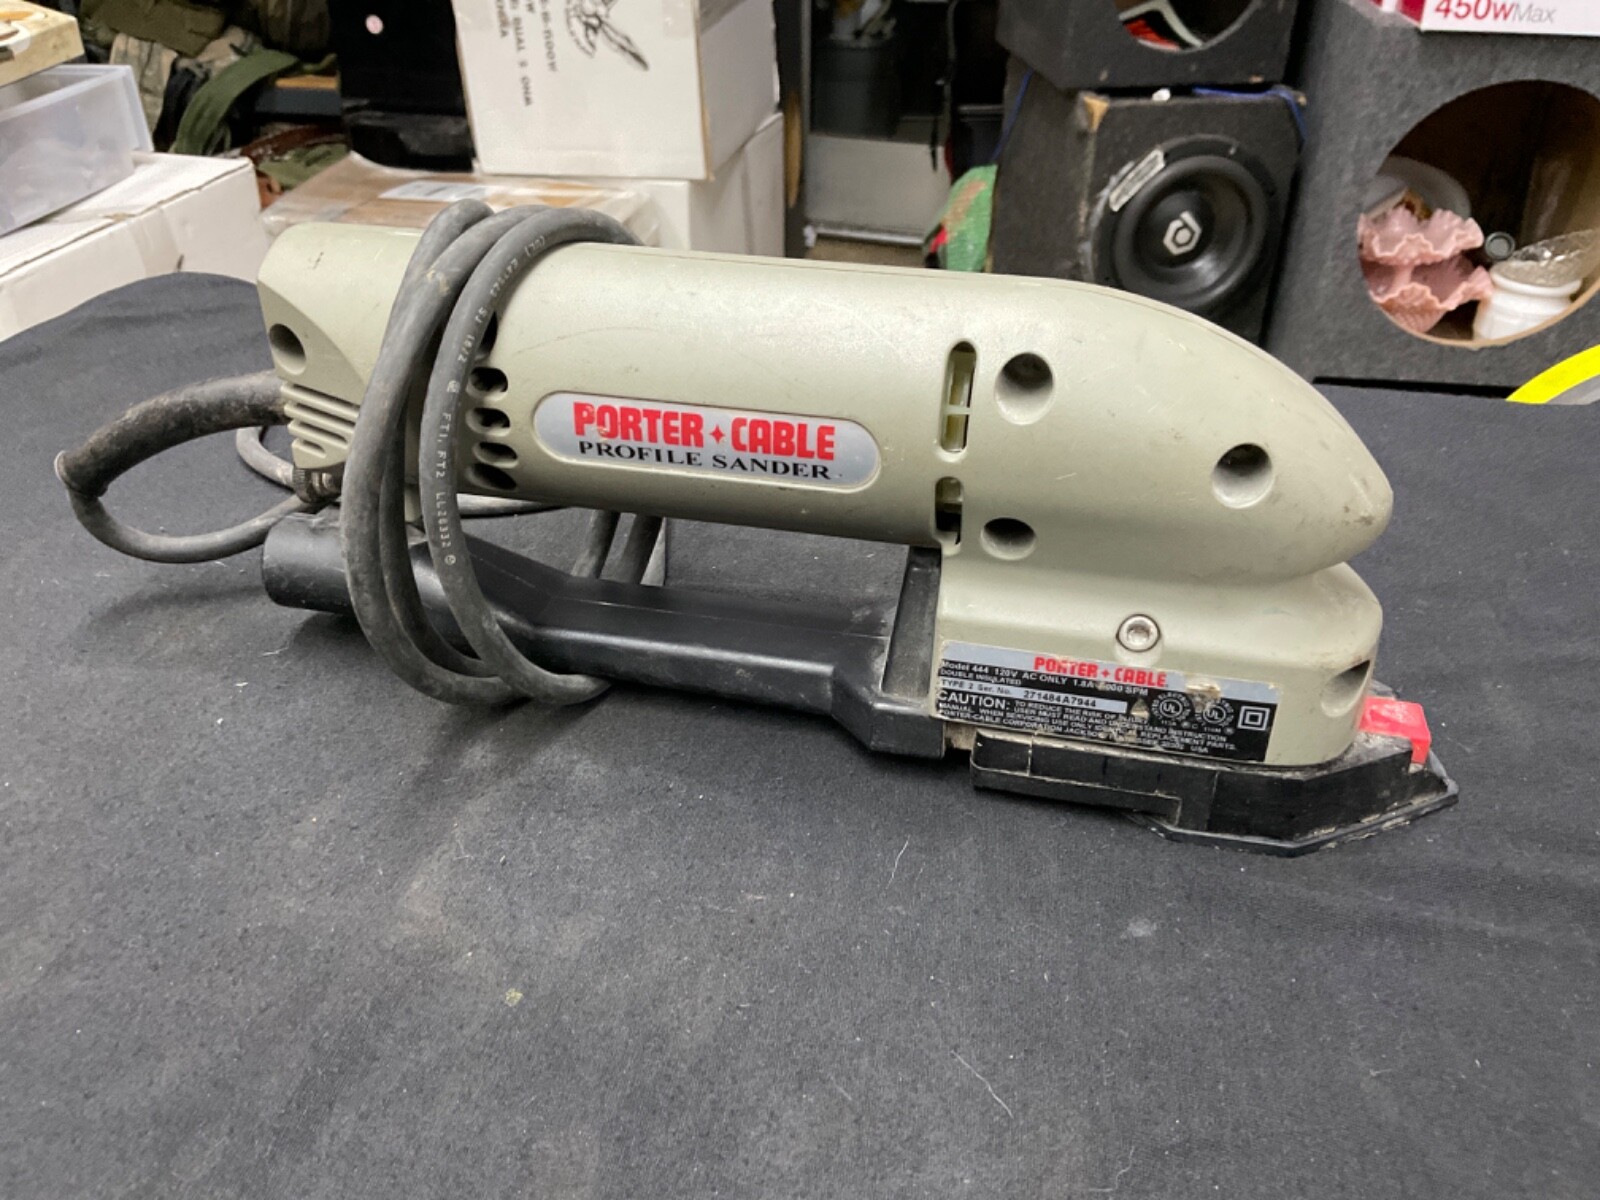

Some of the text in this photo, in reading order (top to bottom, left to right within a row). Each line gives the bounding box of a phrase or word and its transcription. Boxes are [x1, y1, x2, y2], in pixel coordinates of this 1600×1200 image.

[573, 402, 836, 461] PORTER CABLE
[435, 450, 448, 478] FT2
[578, 440, 831, 481] PROFILE SANDER
[940, 669, 1022, 685] DOUBLE INSULATED
[941, 661, 970, 671] Model
[971, 665, 989, 673] 444
[993, 668, 1018, 677] 120V
[1021, 672, 1037, 680] AC
[1038, 674, 1068, 684] ONLY
[1124, 686, 1148, 696] SPM
[941, 679, 964, 688] TYPE
[977, 684, 995, 692] Ser.
[1034, 656, 1168, 688] PORTER CABLE
